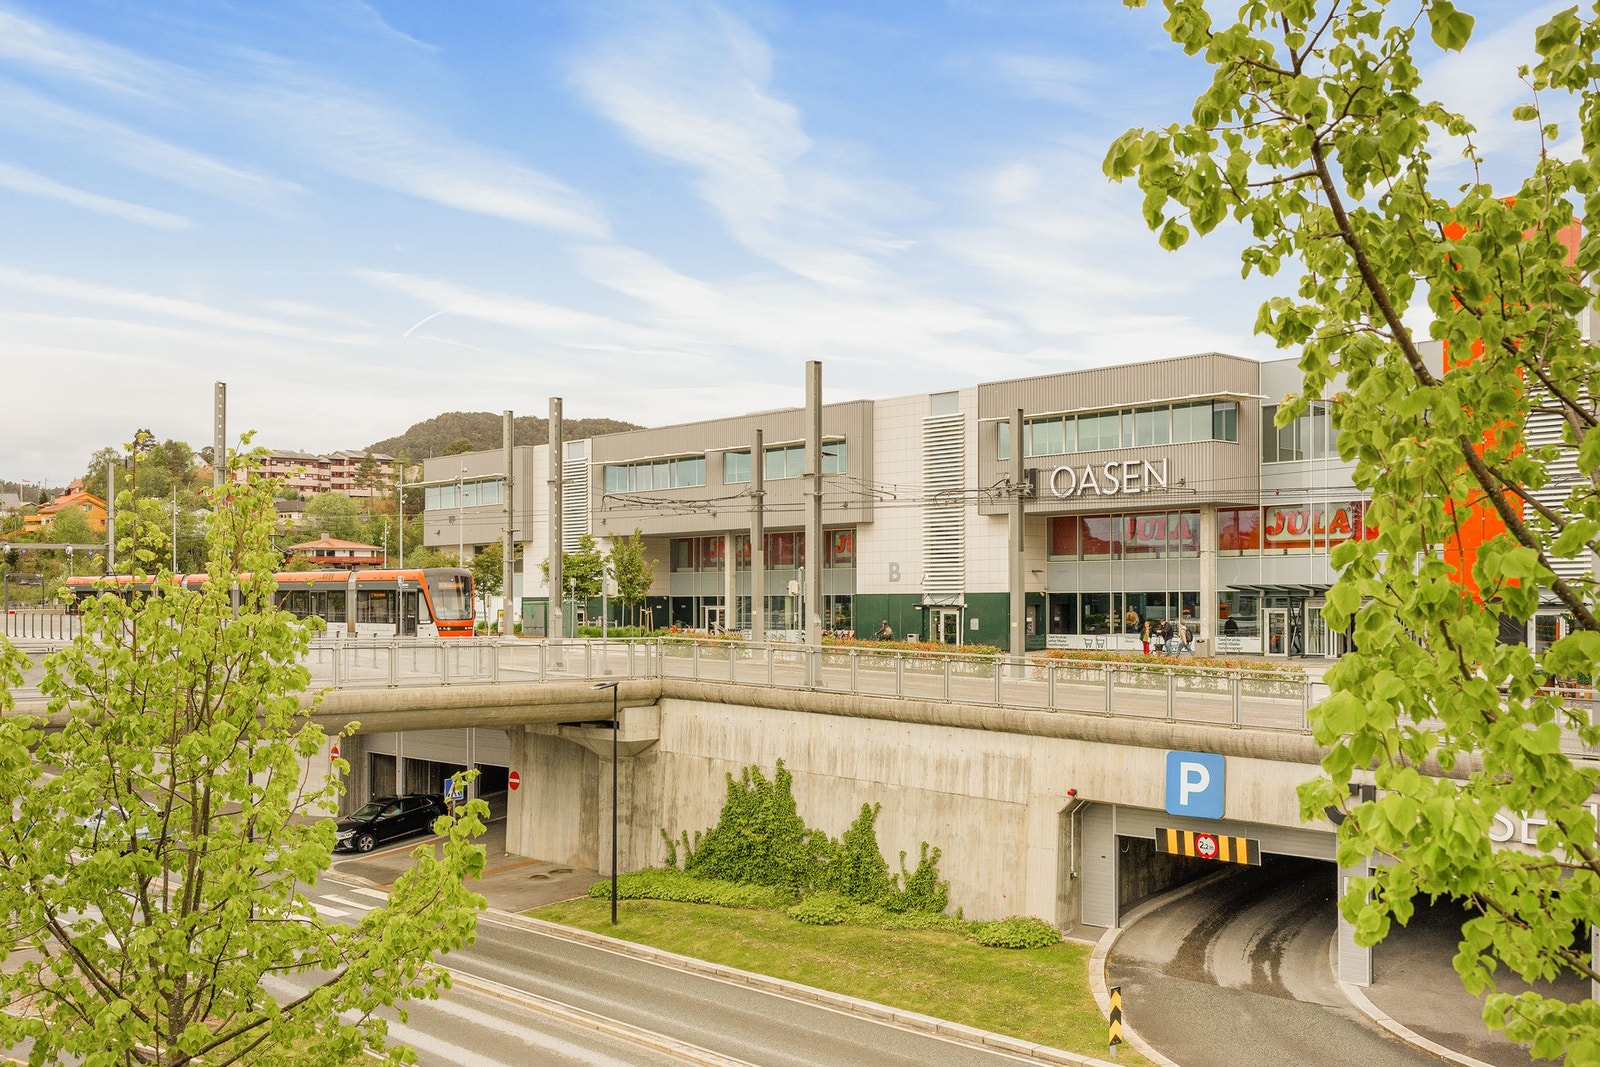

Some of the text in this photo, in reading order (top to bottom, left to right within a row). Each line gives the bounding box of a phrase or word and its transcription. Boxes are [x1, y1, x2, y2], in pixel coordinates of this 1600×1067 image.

[1050, 457, 1168, 498] OASEN
[1265, 508, 1353, 535] JULA
[888, 561, 902, 583] B
[1179, 761, 1210, 806] P
